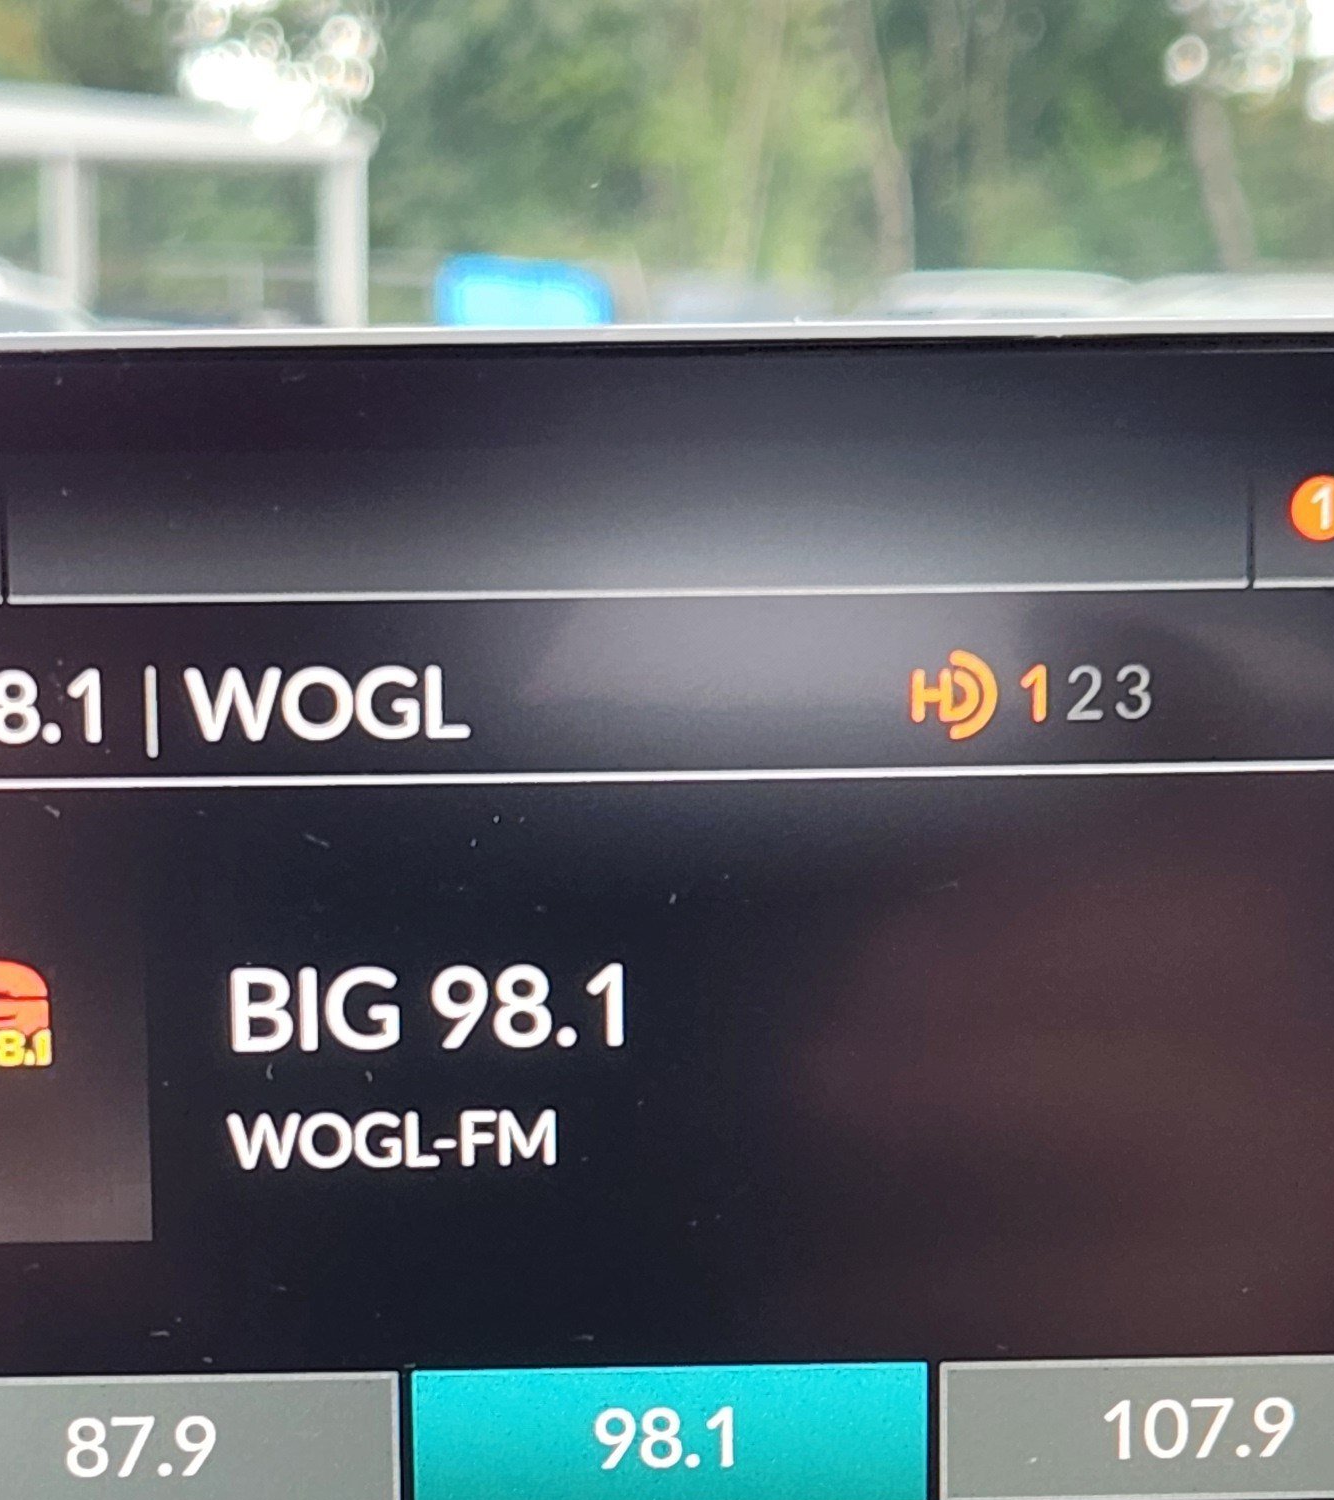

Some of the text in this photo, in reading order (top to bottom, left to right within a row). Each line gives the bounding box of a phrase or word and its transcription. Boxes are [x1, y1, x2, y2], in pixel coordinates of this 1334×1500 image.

[183, 665, 473, 743] WOGL
[229, 964, 626, 1054] BIG 98.1
[227, 1110, 557, 1170] WOGL-FM
[64, 1415, 218, 1479] 87.9
[594, 1406, 739, 1471] 98.1
[1101, 1396, 1297, 1462] 107.9
